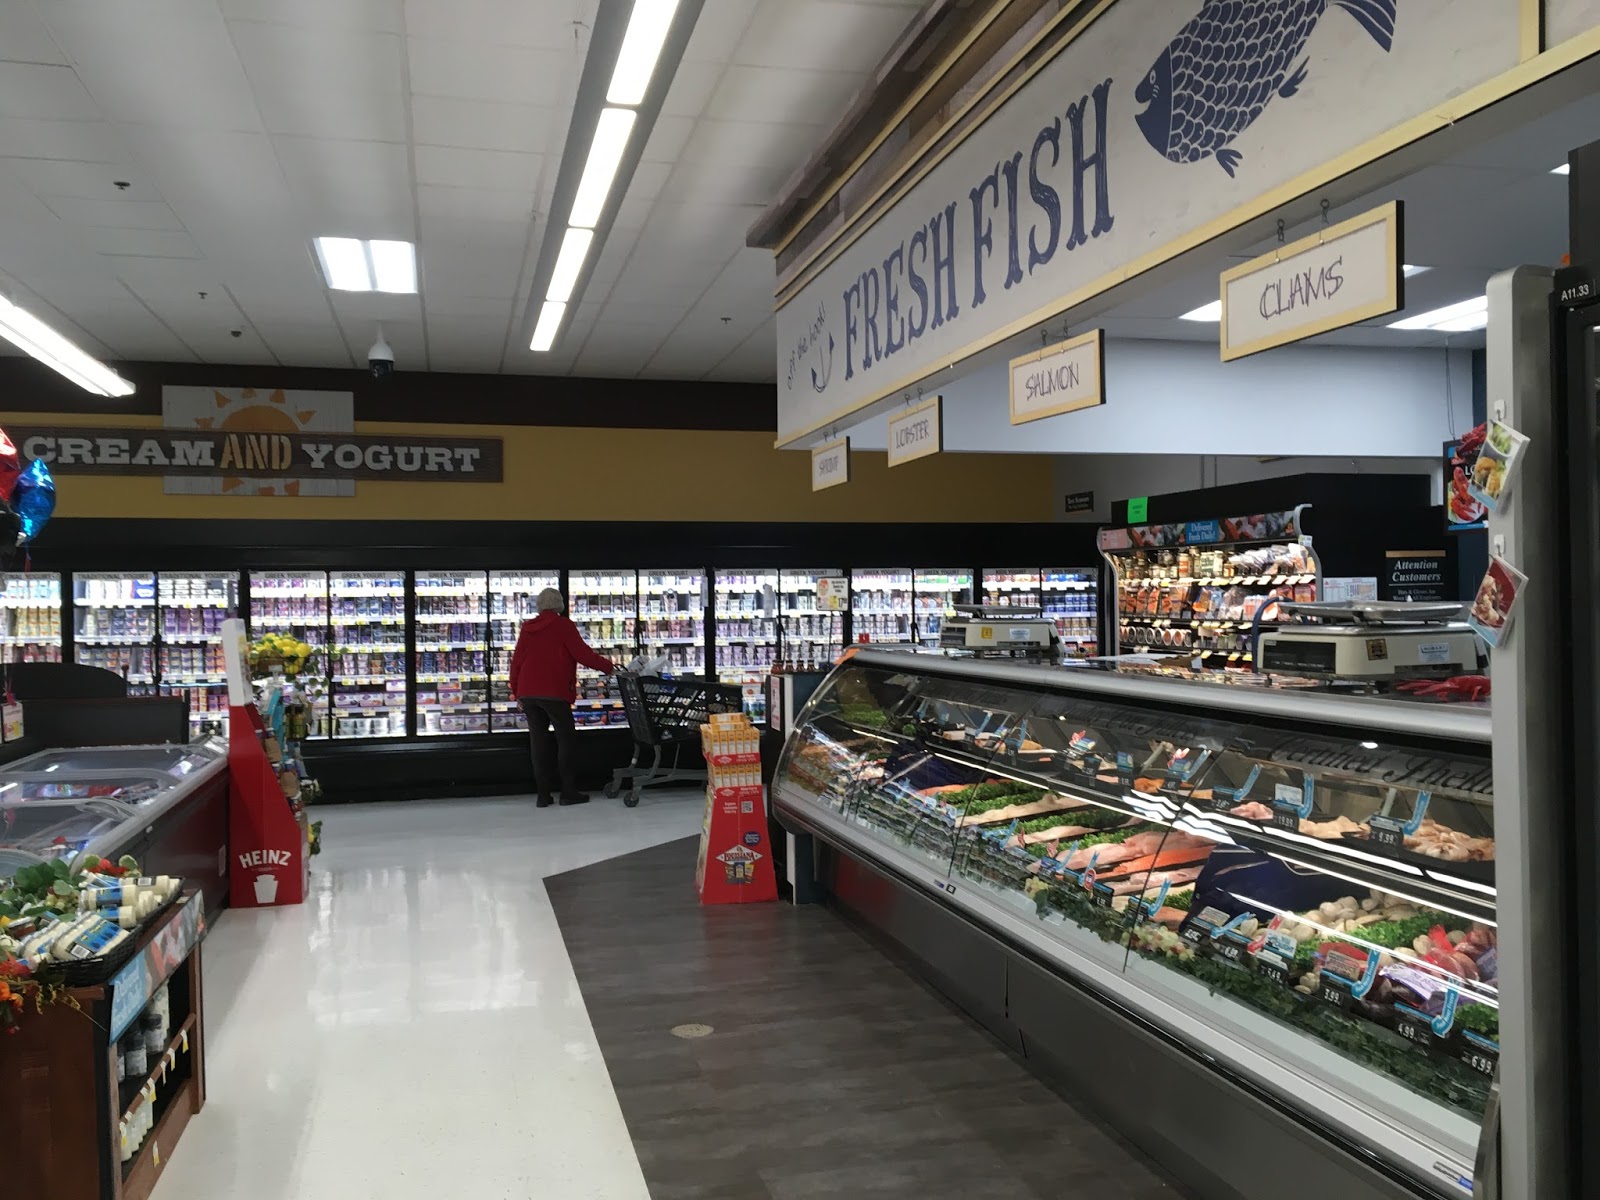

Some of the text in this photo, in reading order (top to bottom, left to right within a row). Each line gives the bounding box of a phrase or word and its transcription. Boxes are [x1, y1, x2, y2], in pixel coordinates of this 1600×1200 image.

[843, 77, 1115, 381] FRESH FISH
[1259, 255, 1344, 321] CLAMS
[1560, 283, 1590, 301] A11.33
[1025, 361, 1080, 402] SALMON
[894, 418, 930, 450] LOBSTER
[22, 433, 480, 472] CREAM AND YOGURT
[1190, 521, 1213, 533] Delivered
[1394, 560, 1438, 570] Attention
[1391, 571, 1442, 582] Customers
[238, 849, 292, 869] HEINZ
[1470, 1055, 1495, 1076] 6.99
